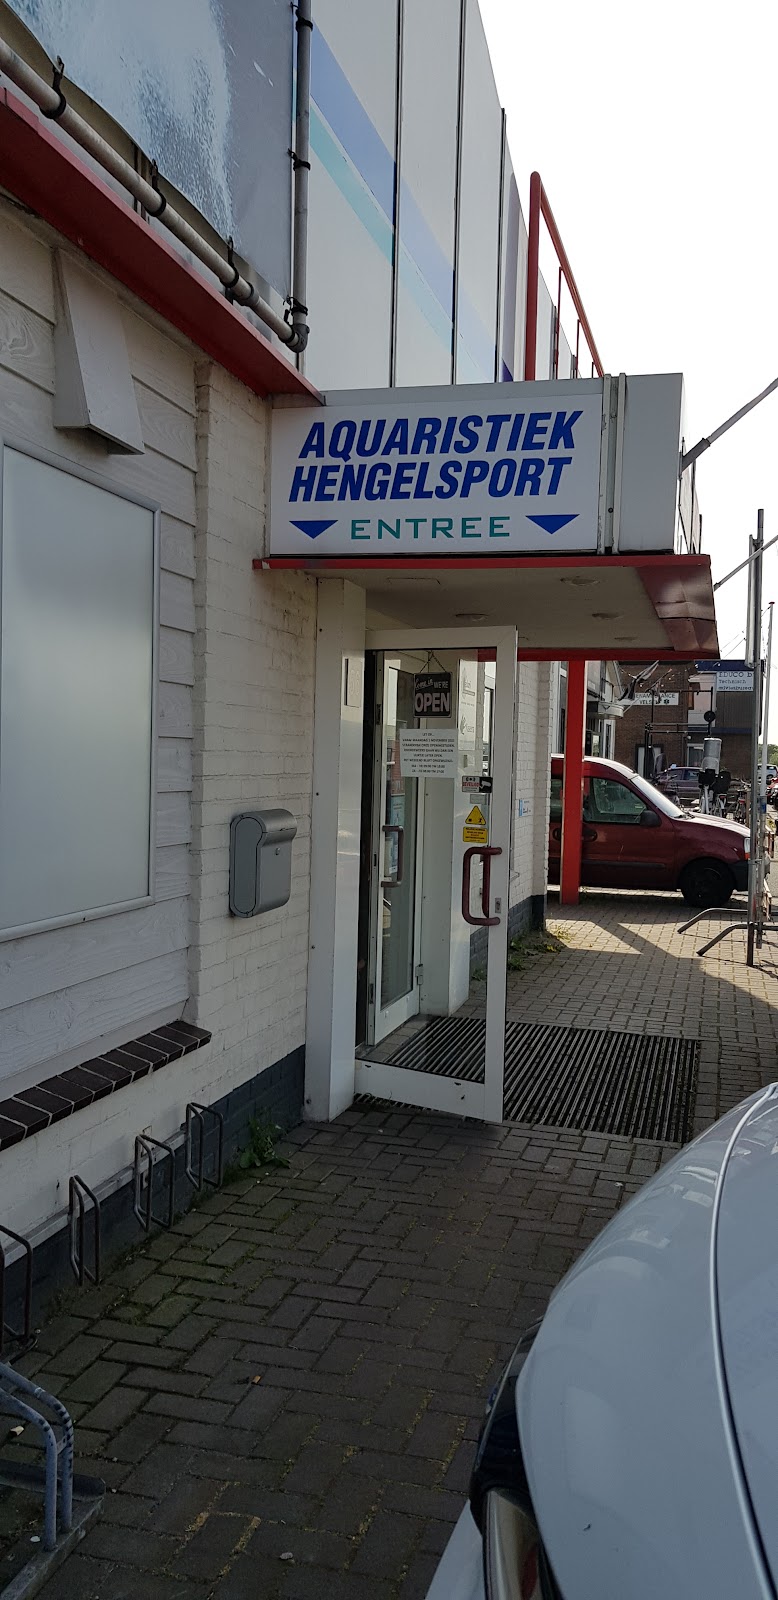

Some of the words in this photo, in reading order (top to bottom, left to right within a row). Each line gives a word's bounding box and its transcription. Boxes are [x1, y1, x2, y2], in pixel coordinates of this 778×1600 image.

[298, 410, 584, 462] AQUARISTIEK
[288, 457, 572, 503] HENGELSPORT
[350, 516, 511, 540] ENTREE
[415, 692, 450, 712] OPEN
